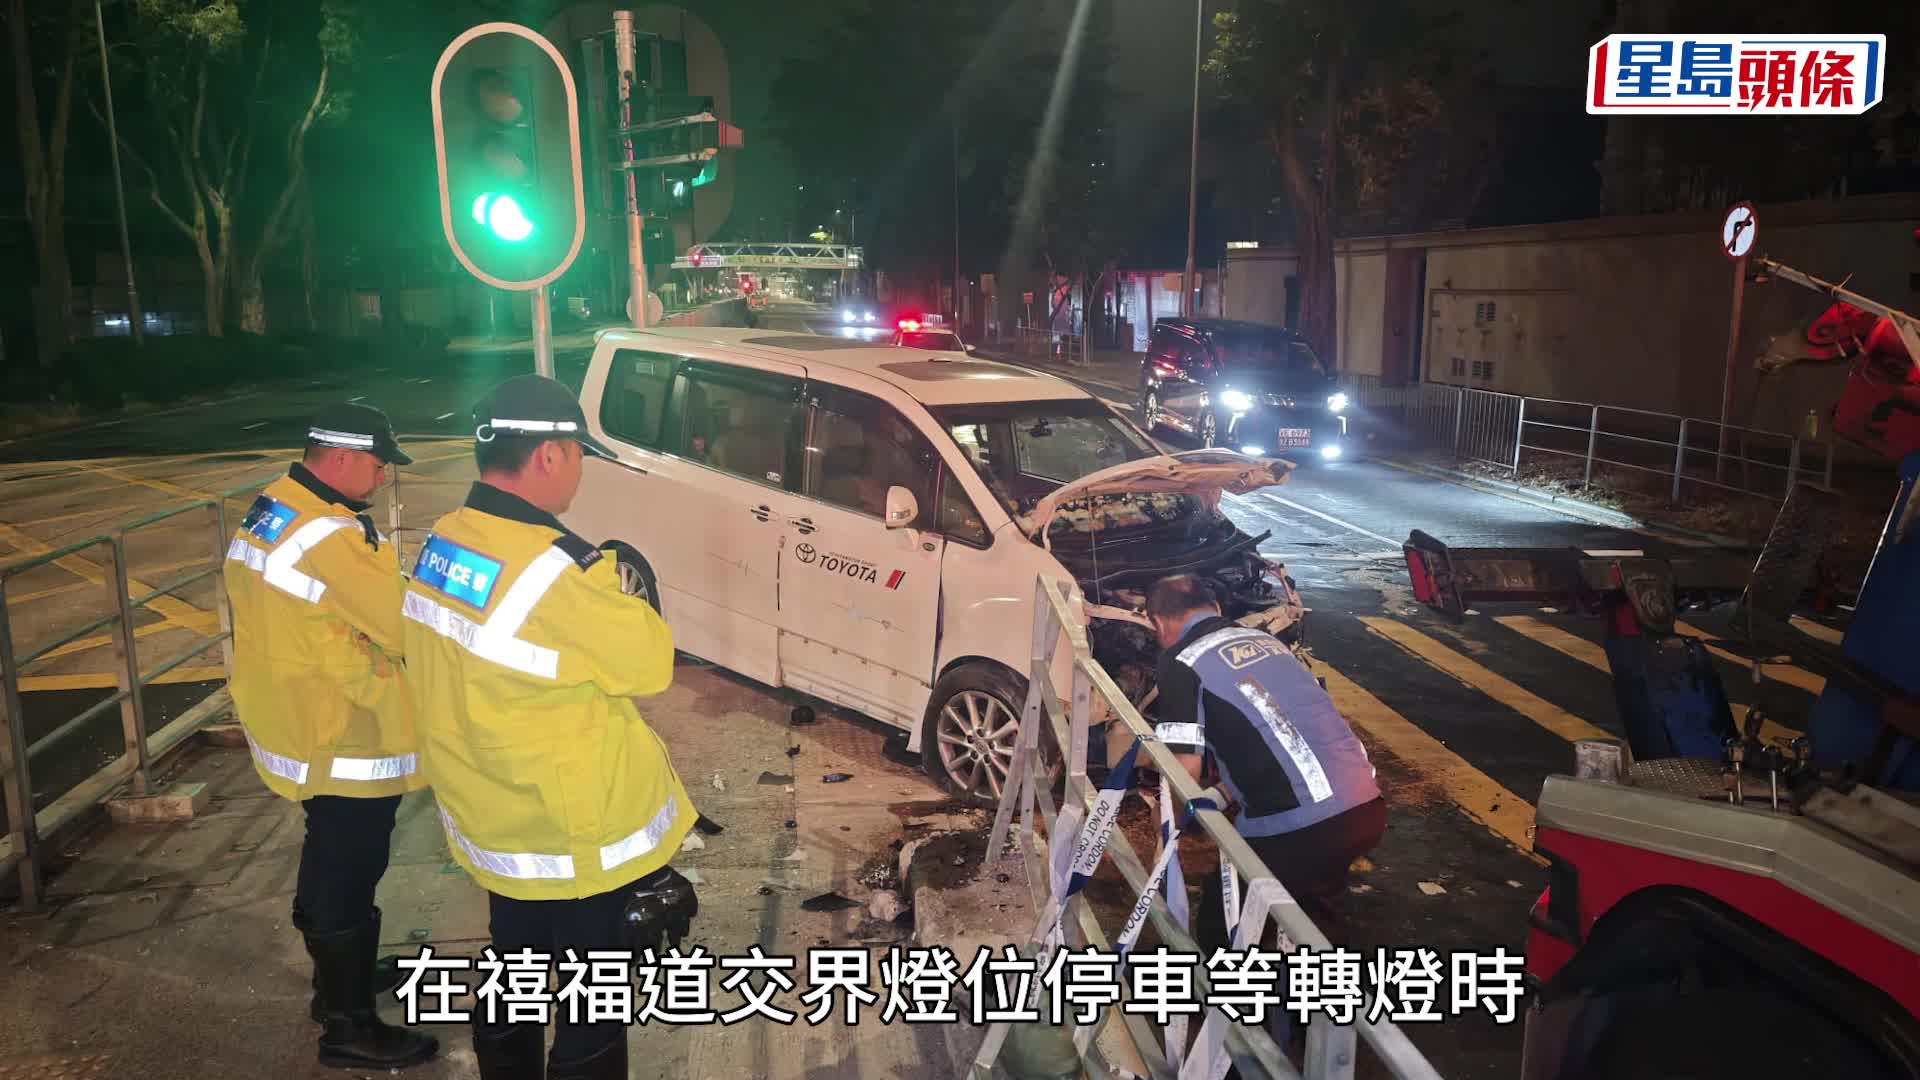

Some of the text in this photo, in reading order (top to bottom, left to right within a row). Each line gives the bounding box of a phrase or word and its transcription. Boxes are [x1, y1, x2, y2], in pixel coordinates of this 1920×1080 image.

[428, 552, 473, 587] POLICE
[819, 555, 878, 584] TOYOTA
[1099, 800, 1110, 817] DO
[1085, 815, 1102, 836] NOT
